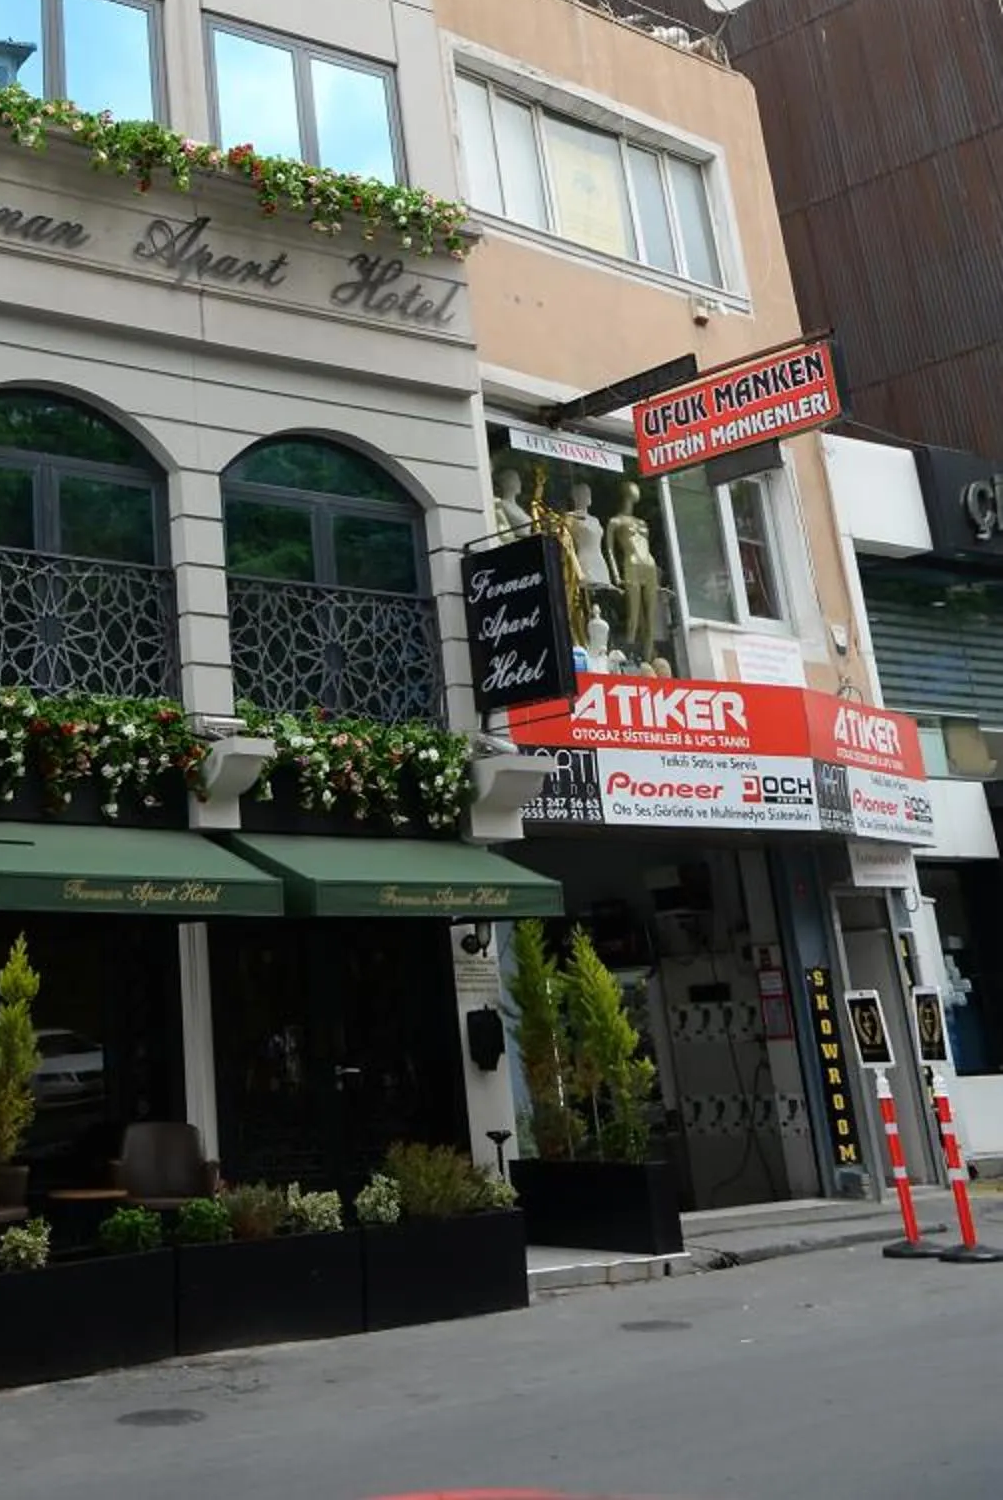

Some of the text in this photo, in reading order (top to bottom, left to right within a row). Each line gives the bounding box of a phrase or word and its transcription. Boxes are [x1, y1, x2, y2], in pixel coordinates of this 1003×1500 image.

[133, 215, 291, 290] Apart
[329, 252, 457, 325] Hotel
[644, 351, 825, 437] UFUK MANKEN
[648, 387, 832, 467] VİTRİN MANKENLERİ
[468, 568, 543, 604] Ferman
[478, 604, 540, 647] Apart
[482, 649, 548, 692] Hotel
[572, 728, 621, 742] OTOGAZ
[606, 771, 724, 799] Pioneer
[812, 970, 857, 1163] SHOWROOM
